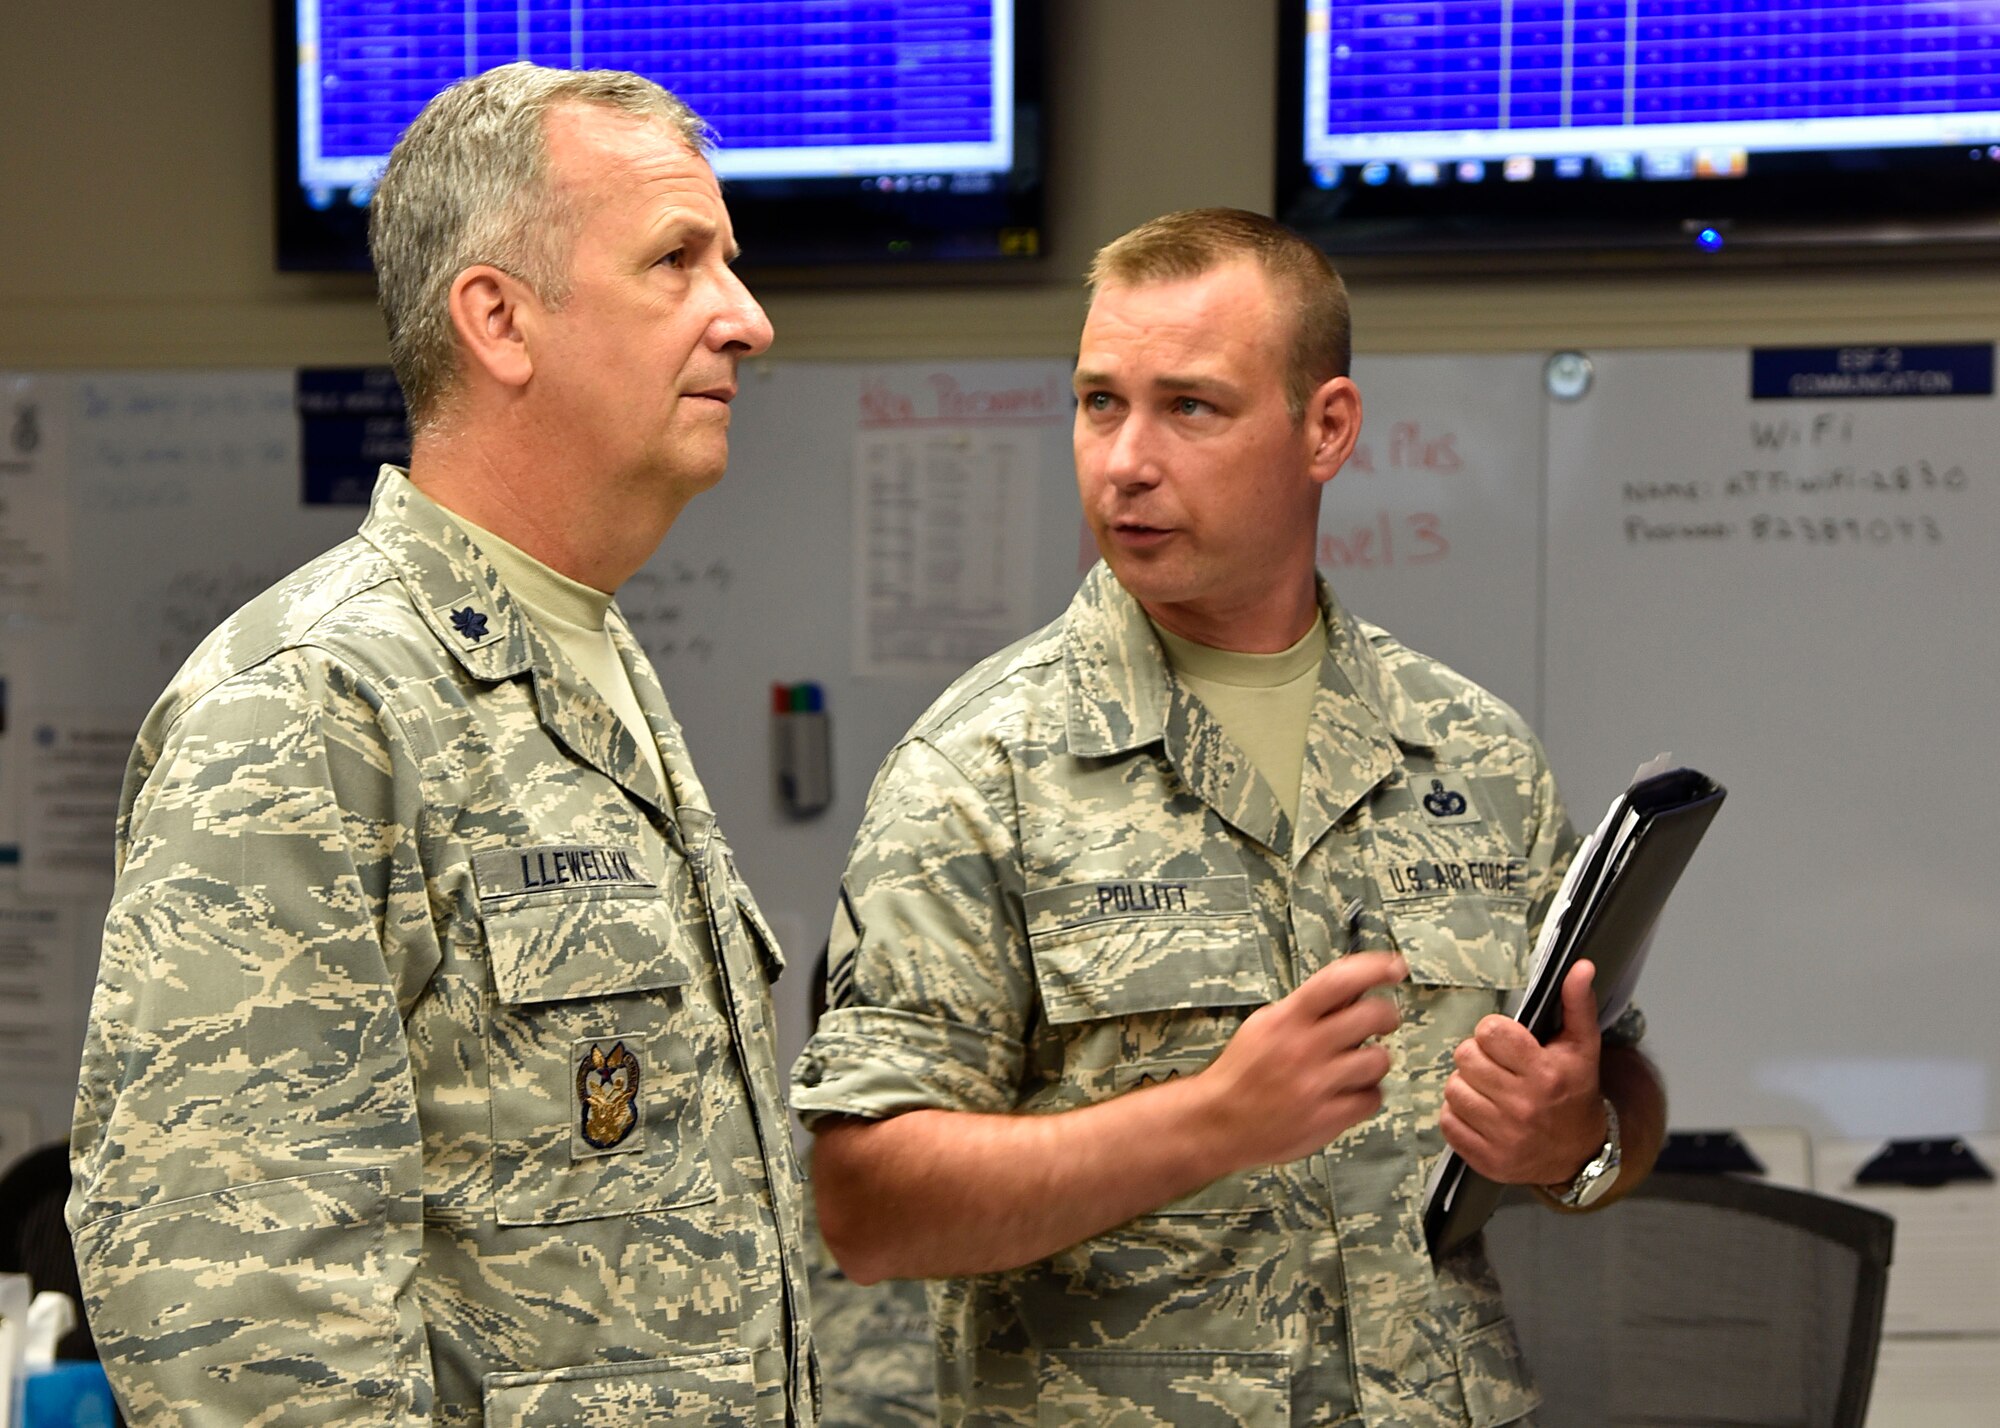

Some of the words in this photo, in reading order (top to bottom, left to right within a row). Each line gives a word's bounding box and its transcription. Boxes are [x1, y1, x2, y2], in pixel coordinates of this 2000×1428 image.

[1405, 512, 1451, 566] 3
[521, 850, 637, 888] LLEWELLYN
[1388, 867, 1430, 893] U.S.
[1433, 863, 1466, 890] AIR
[1468, 861, 1517, 891] FORCE
[1097, 883, 1188, 914] POLLITT
